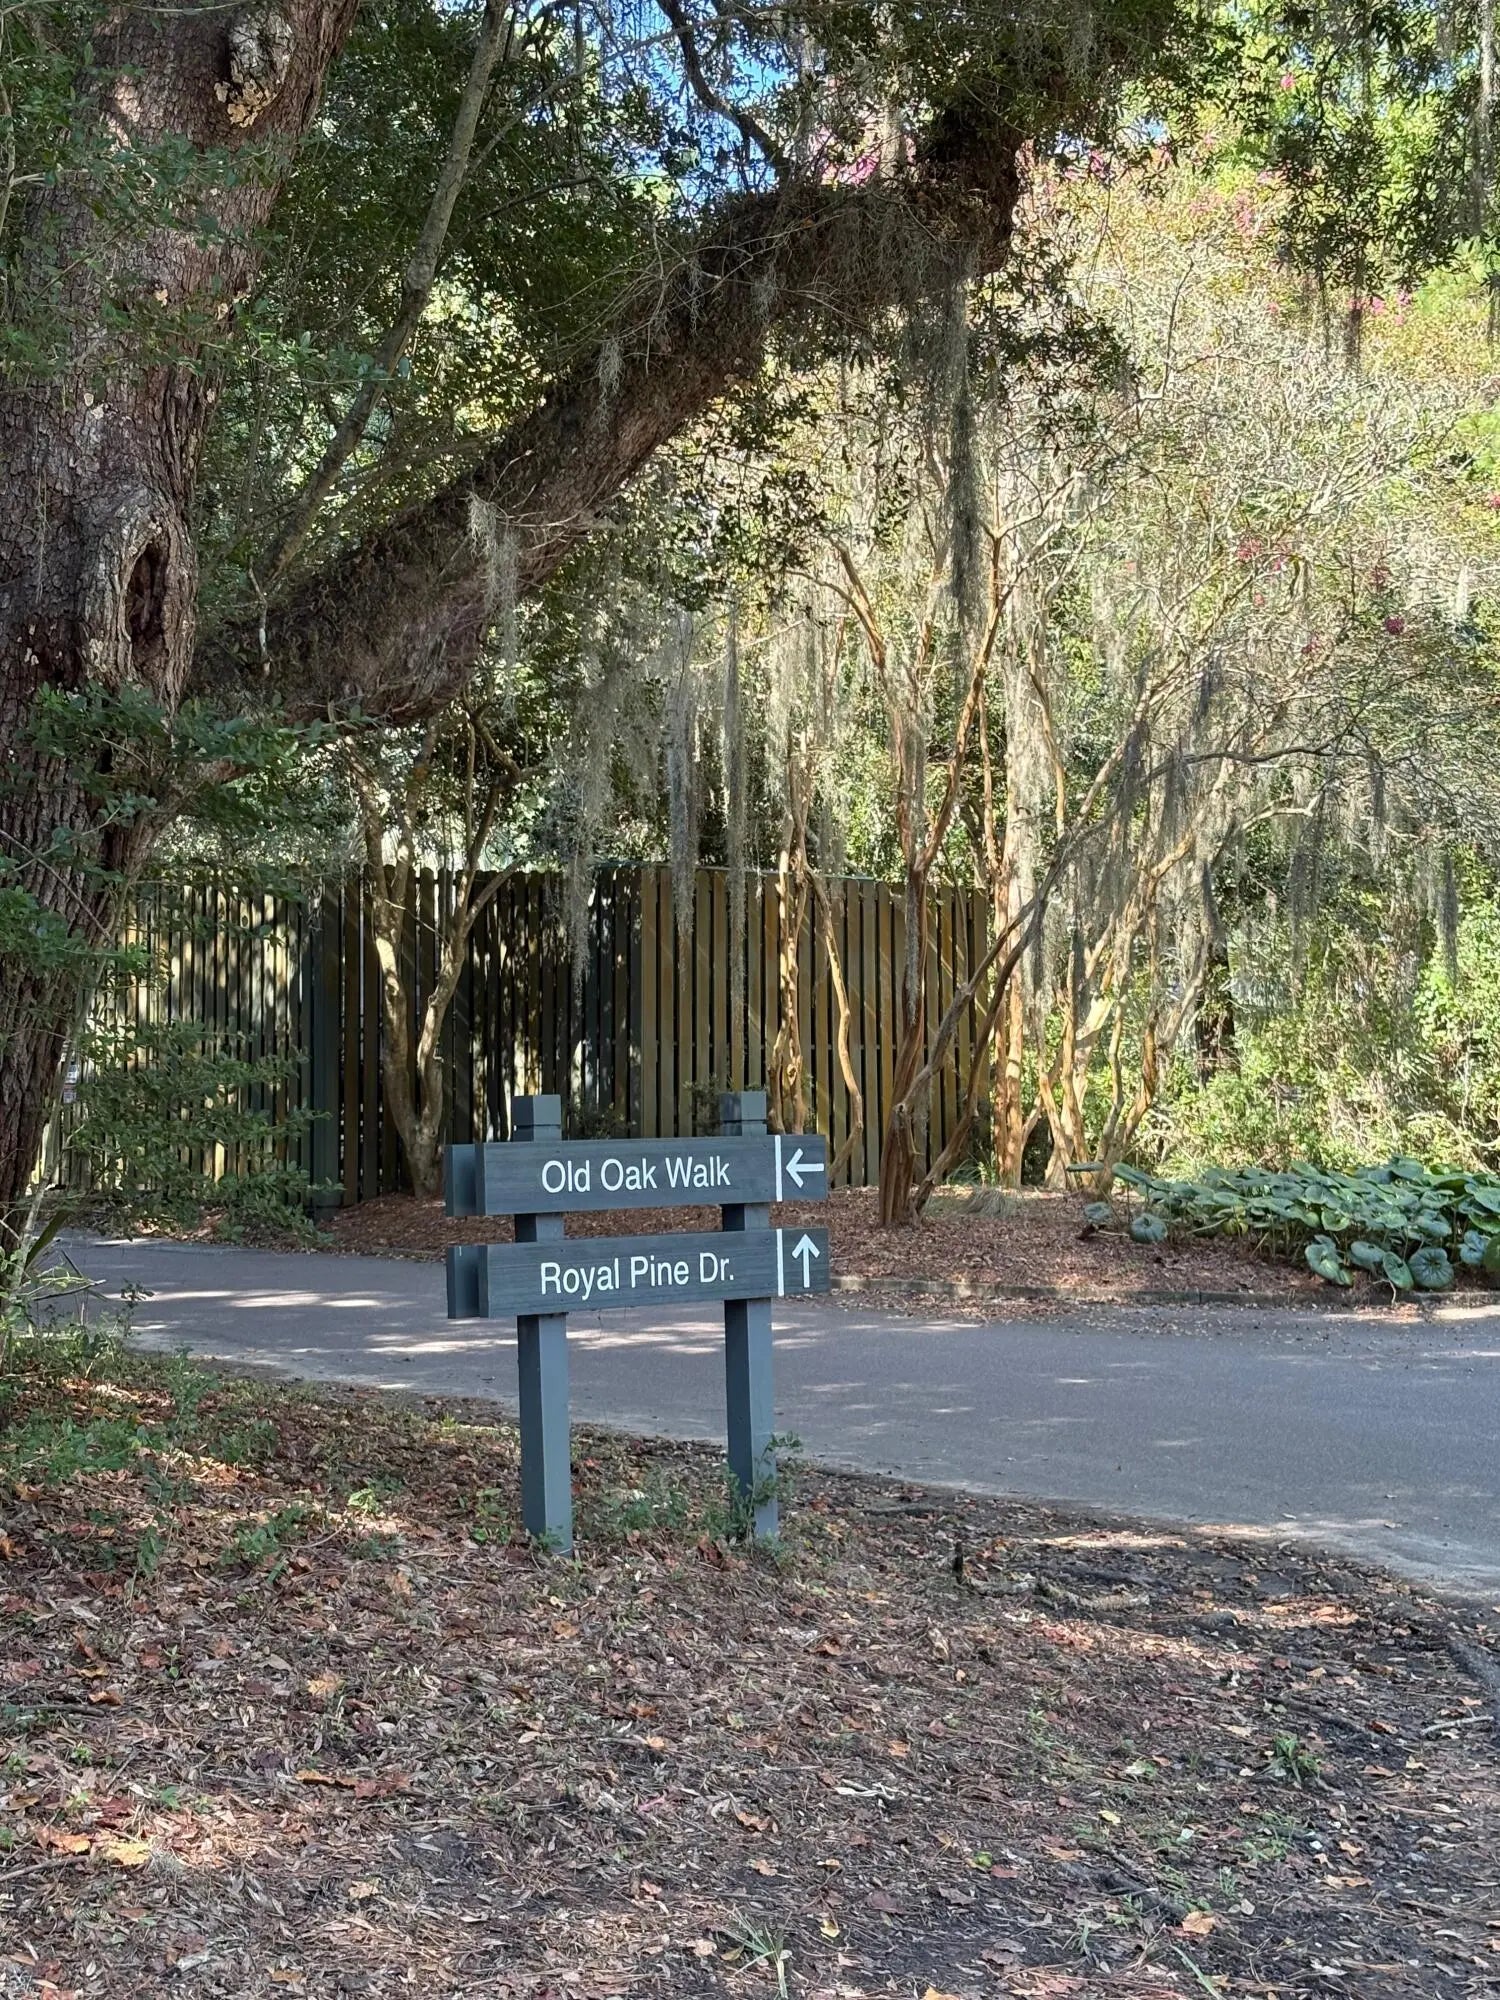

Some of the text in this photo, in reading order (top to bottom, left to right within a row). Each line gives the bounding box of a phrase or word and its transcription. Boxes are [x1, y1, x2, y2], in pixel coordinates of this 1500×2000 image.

[541, 1155, 731, 1193] Old Oak Walk
[540, 1252, 735, 1301] Royal Pine Dr.
